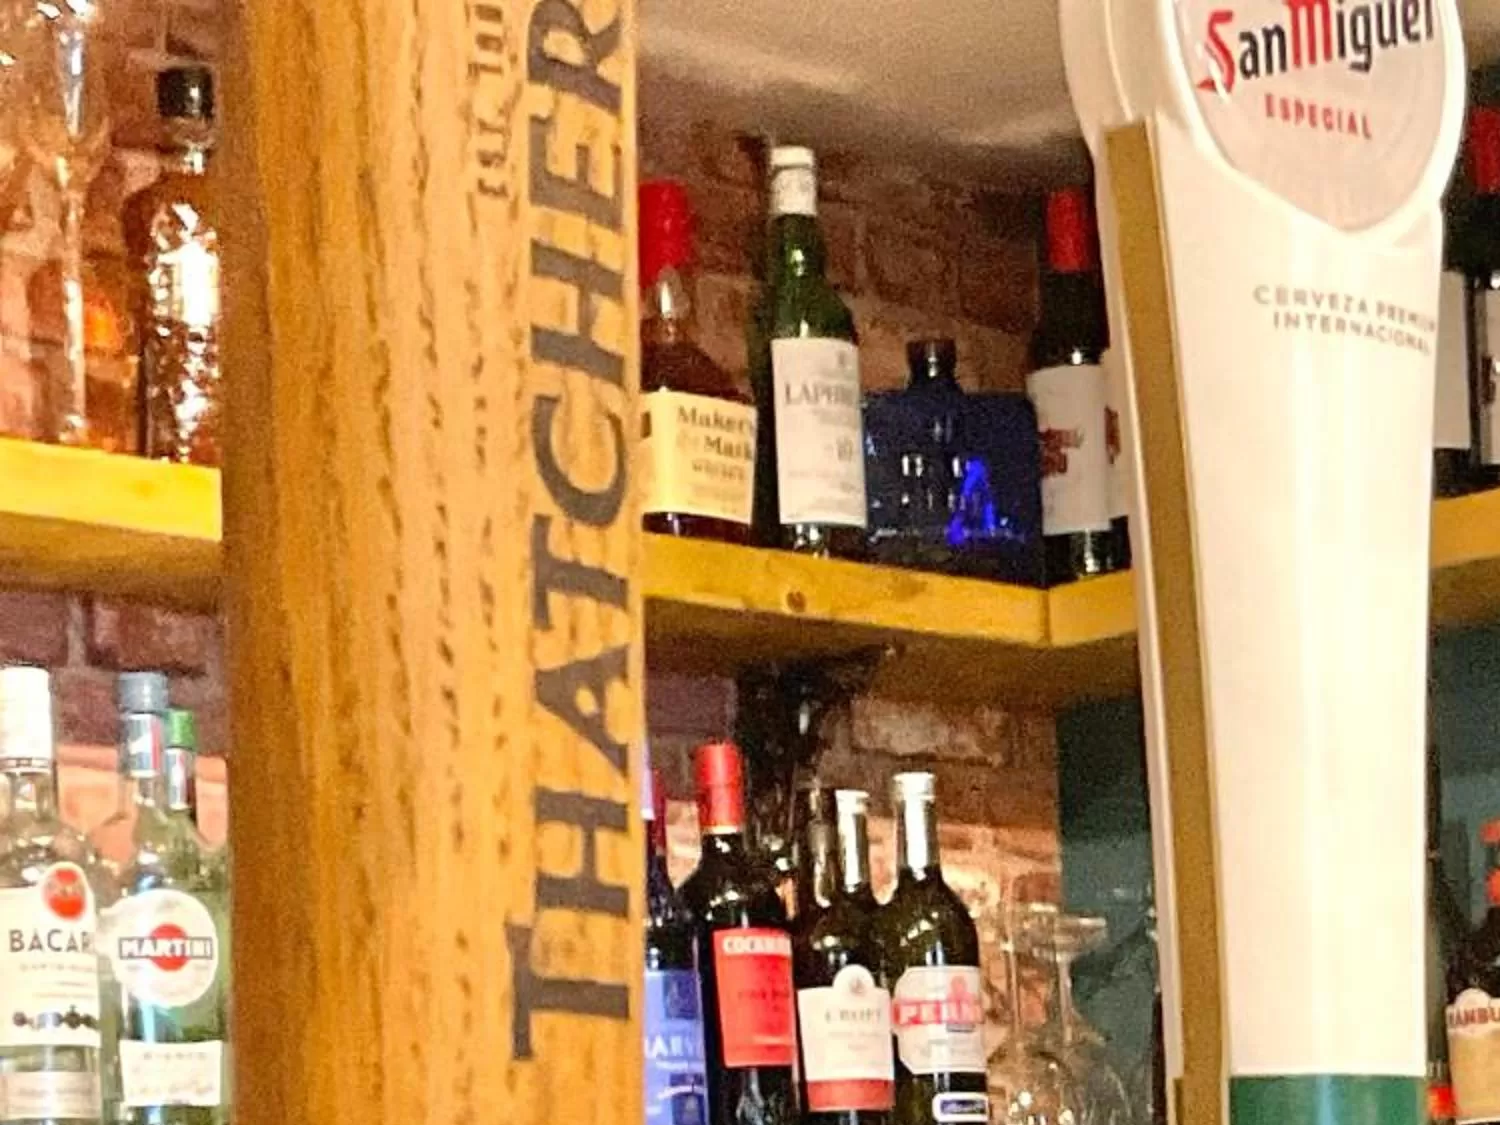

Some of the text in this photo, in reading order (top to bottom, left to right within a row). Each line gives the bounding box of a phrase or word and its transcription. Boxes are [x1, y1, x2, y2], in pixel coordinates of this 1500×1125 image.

[1265, 92, 1373, 140] ESPECIAL
[1252, 284, 1369, 315] CERVEZA
[504, 0, 630, 1061] THATCHER
[118, 937, 213, 960] MARTINI
